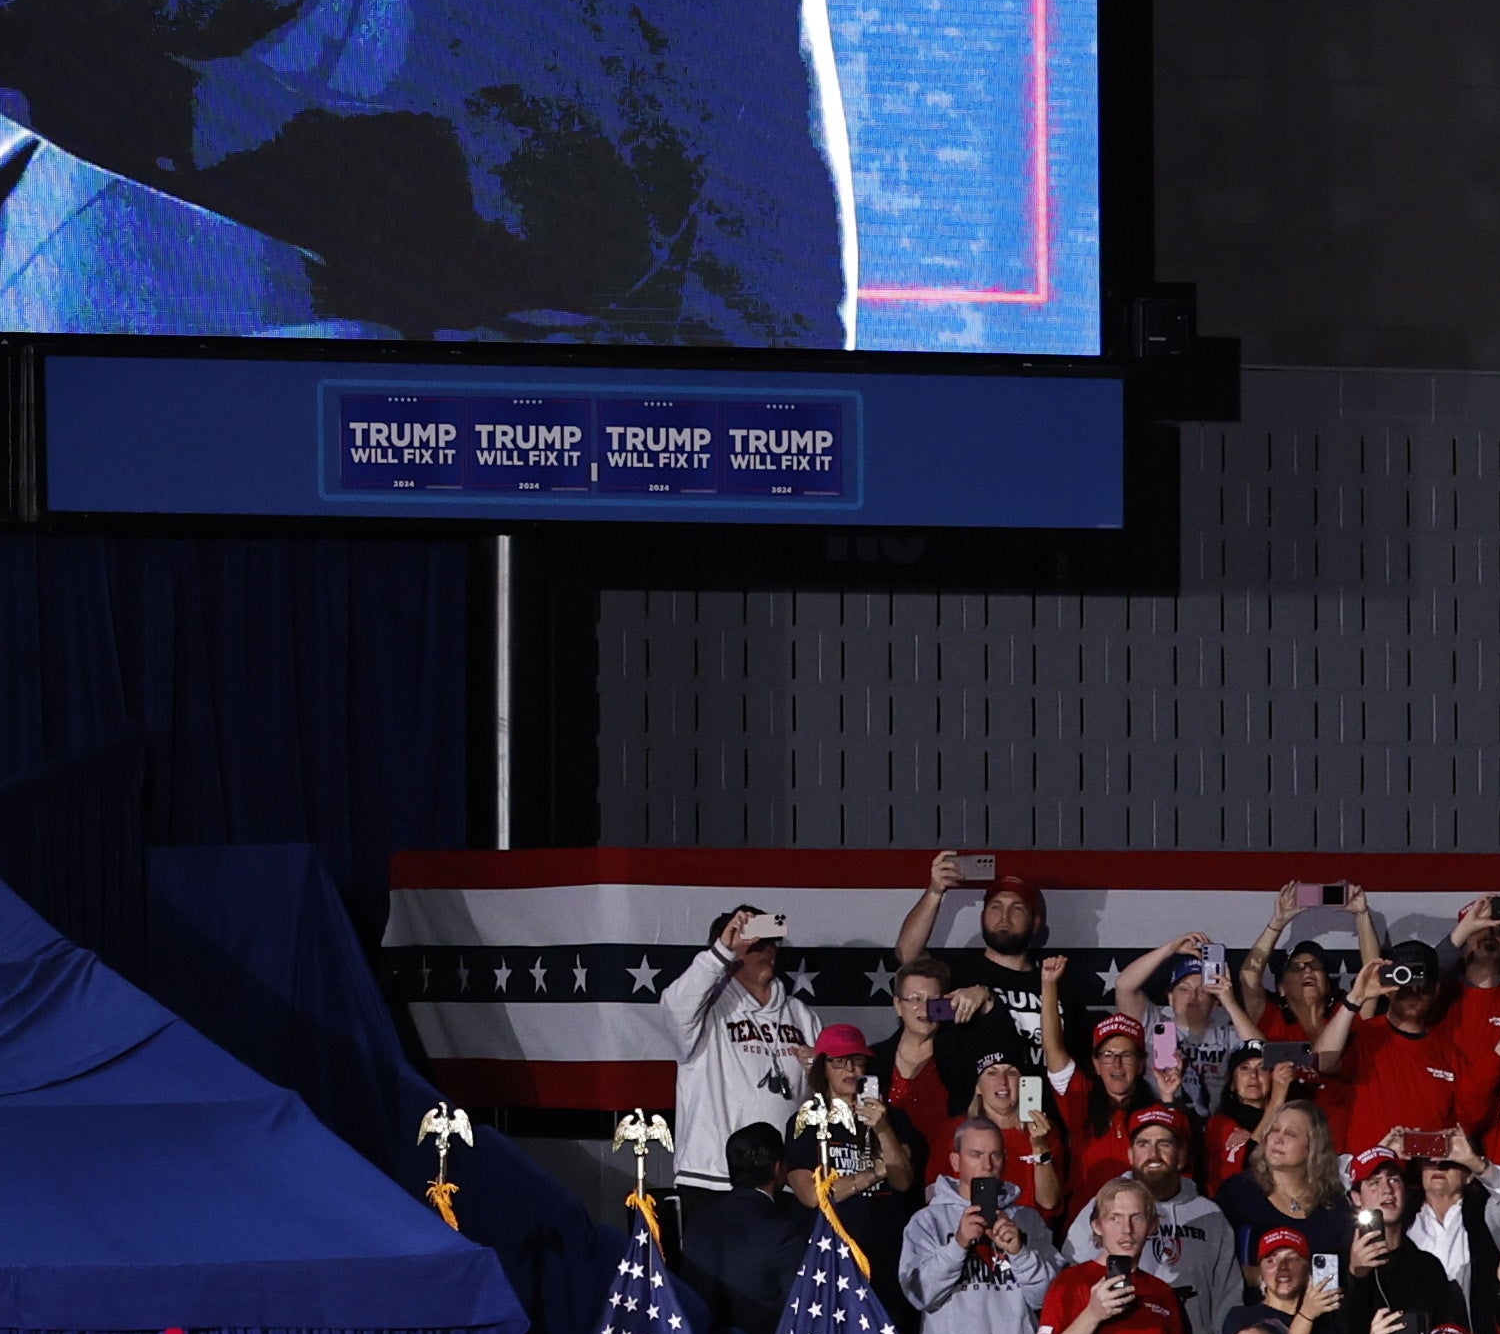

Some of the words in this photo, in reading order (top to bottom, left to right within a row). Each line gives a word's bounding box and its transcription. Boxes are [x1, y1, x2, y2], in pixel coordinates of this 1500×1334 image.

[349, 422, 457, 449] TRUMP
[474, 424, 582, 450] TRUMP
[605, 426, 712, 452] TRUMP
[728, 429, 834, 455] TRUMP
[350, 447, 401, 466] WILL
[404, 447, 435, 466] FIX
[438, 447, 456, 466] IT
[476, 449, 525, 468] WILL
[528, 449, 559, 468] FIX
[563, 449, 581, 468] IT
[607, 451, 656, 470] WILL
[658, 451, 690, 470] FIX
[693, 451, 711, 470] IT
[729, 453, 779, 472] WILL
[781, 453, 812, 472] FIX
[815, 453, 833, 472] IT
